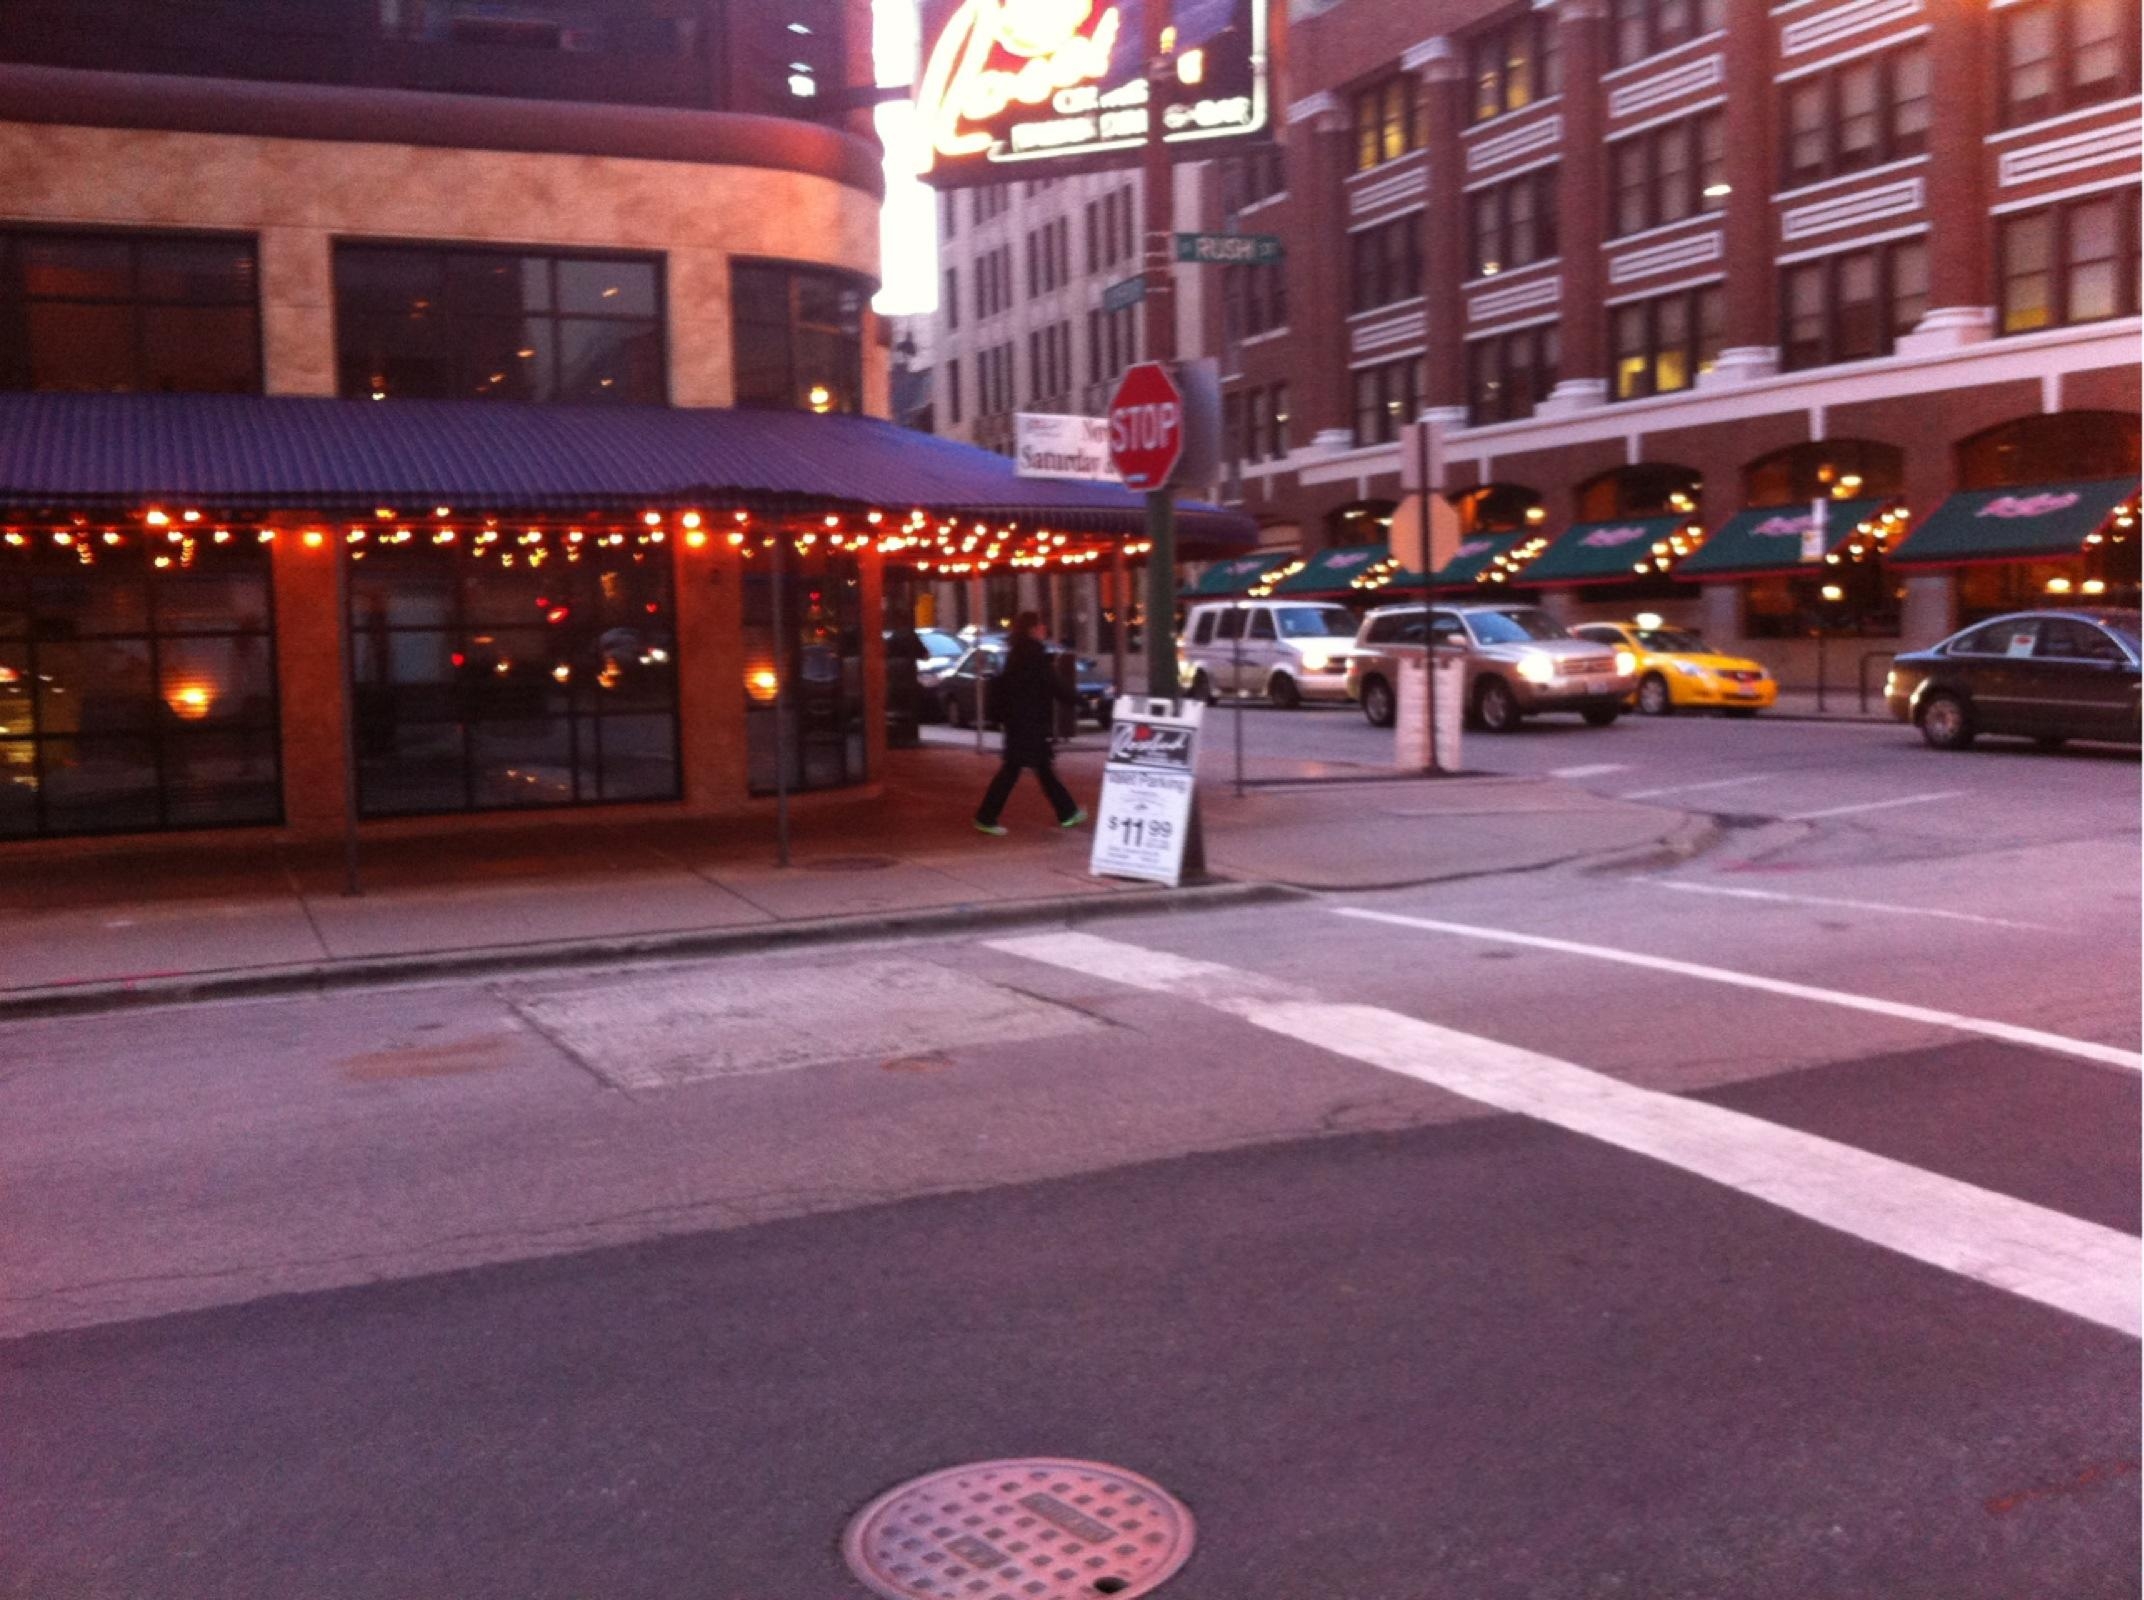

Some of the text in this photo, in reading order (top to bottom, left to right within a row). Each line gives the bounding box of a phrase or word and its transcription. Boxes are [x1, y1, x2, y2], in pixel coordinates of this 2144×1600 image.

[1196, 238, 1254, 260] RUSH
[1111, 402, 1179, 453] STOP
[1021, 444, 1104, 477] Saturday
